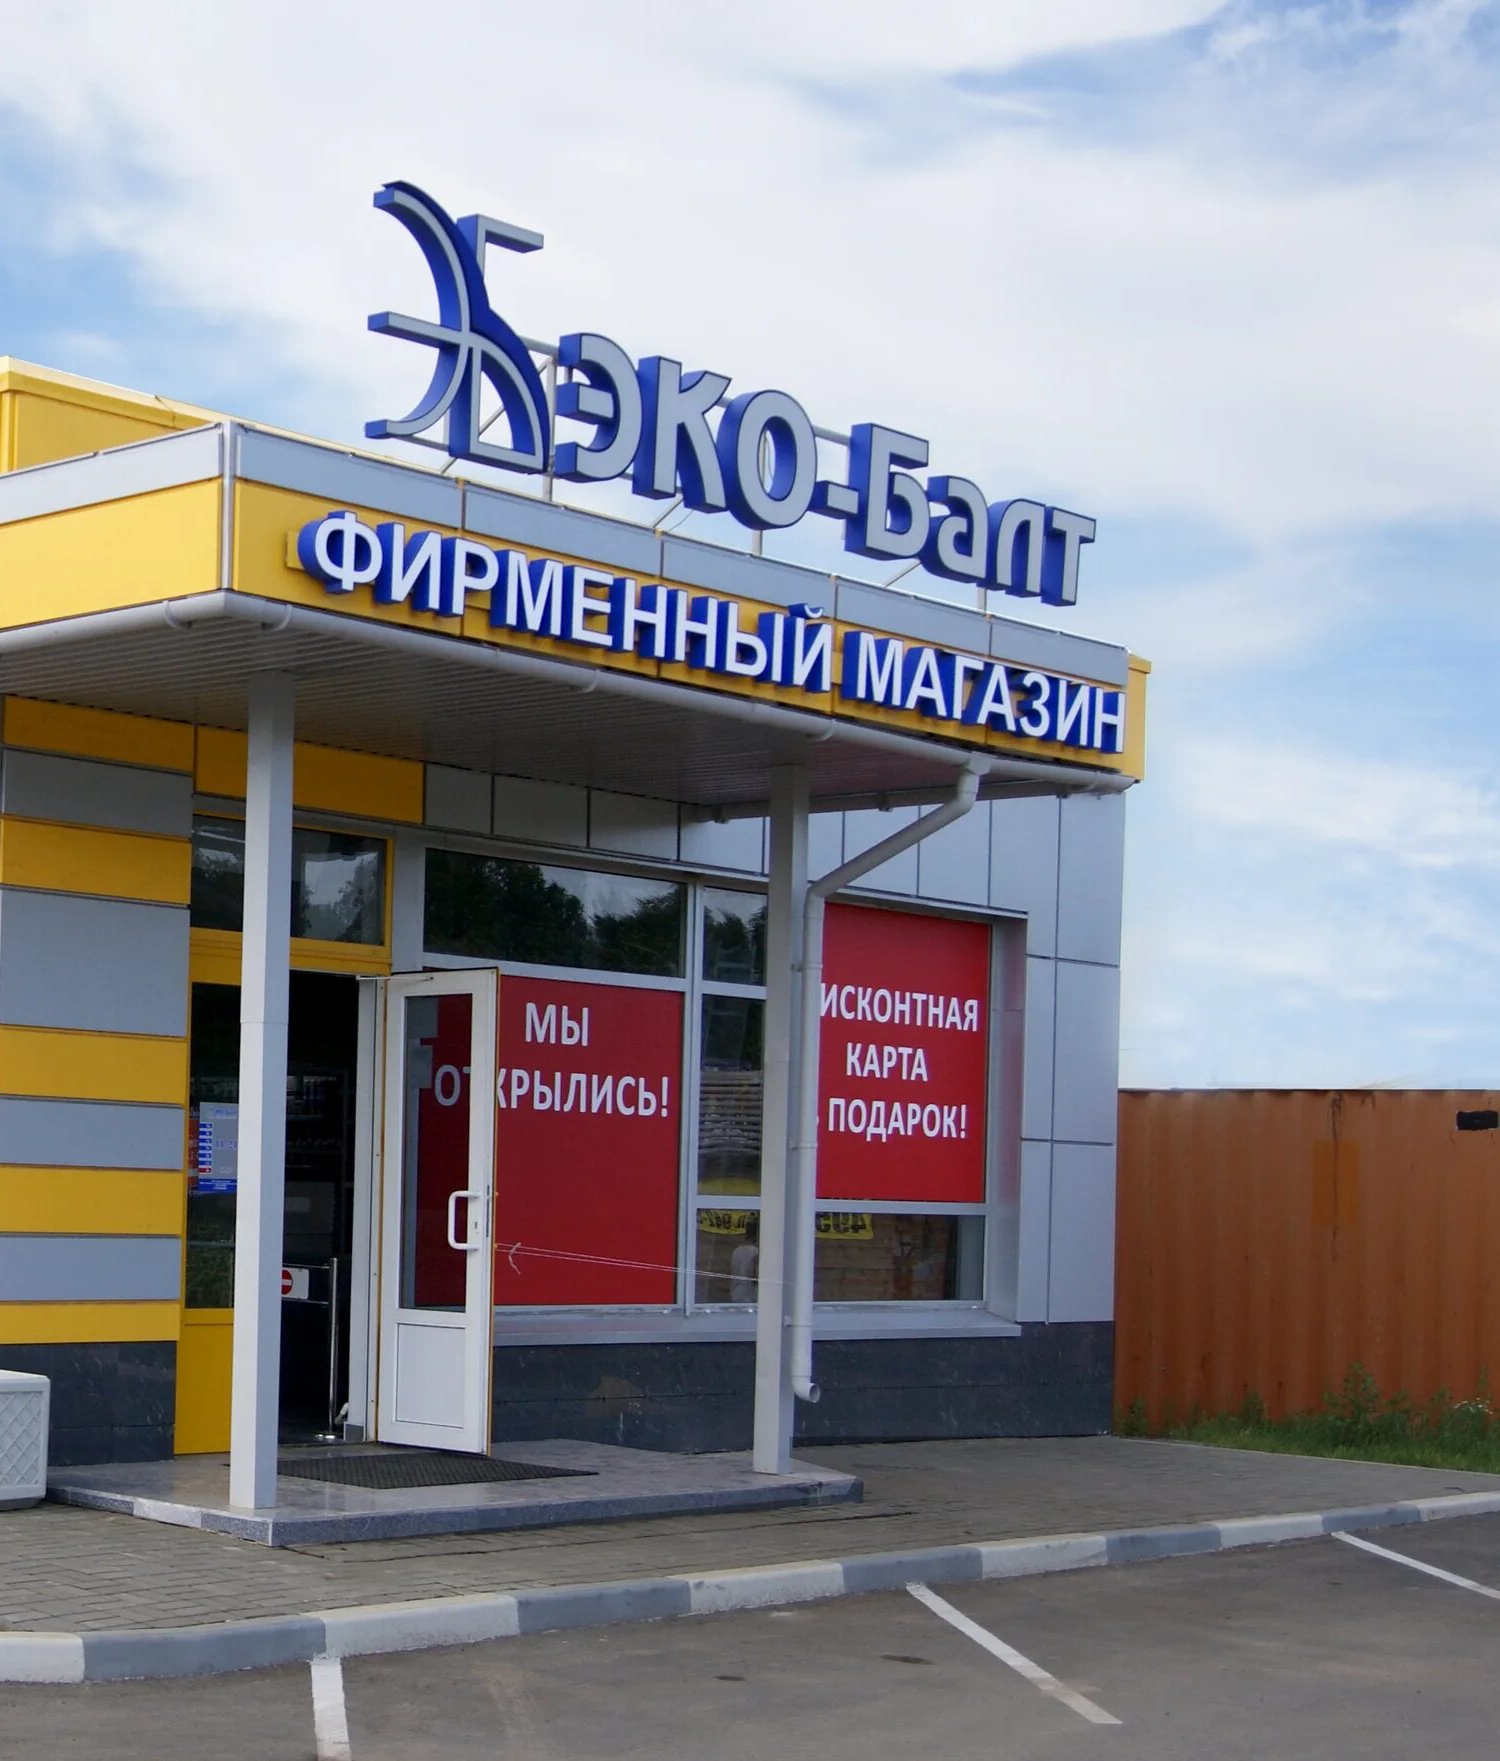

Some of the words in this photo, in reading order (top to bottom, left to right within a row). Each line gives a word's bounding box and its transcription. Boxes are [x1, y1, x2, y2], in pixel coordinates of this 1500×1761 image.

[554, 332, 1097, 607] ЭКО-Балт
[298, 510, 833, 694] ФИРМЕННЫЙ
[841, 631, 1126, 754] МАГАЗИН
[525, 1002, 589, 1046] МЫ
[819, 983, 978, 1032] ИСКОНТНАЯ
[846, 1042, 929, 1082] КАРТА
[434, 1064, 668, 1117] ОКРЫЛИСЬ!
[828, 1097, 967, 1142] ПОДАРОК!
